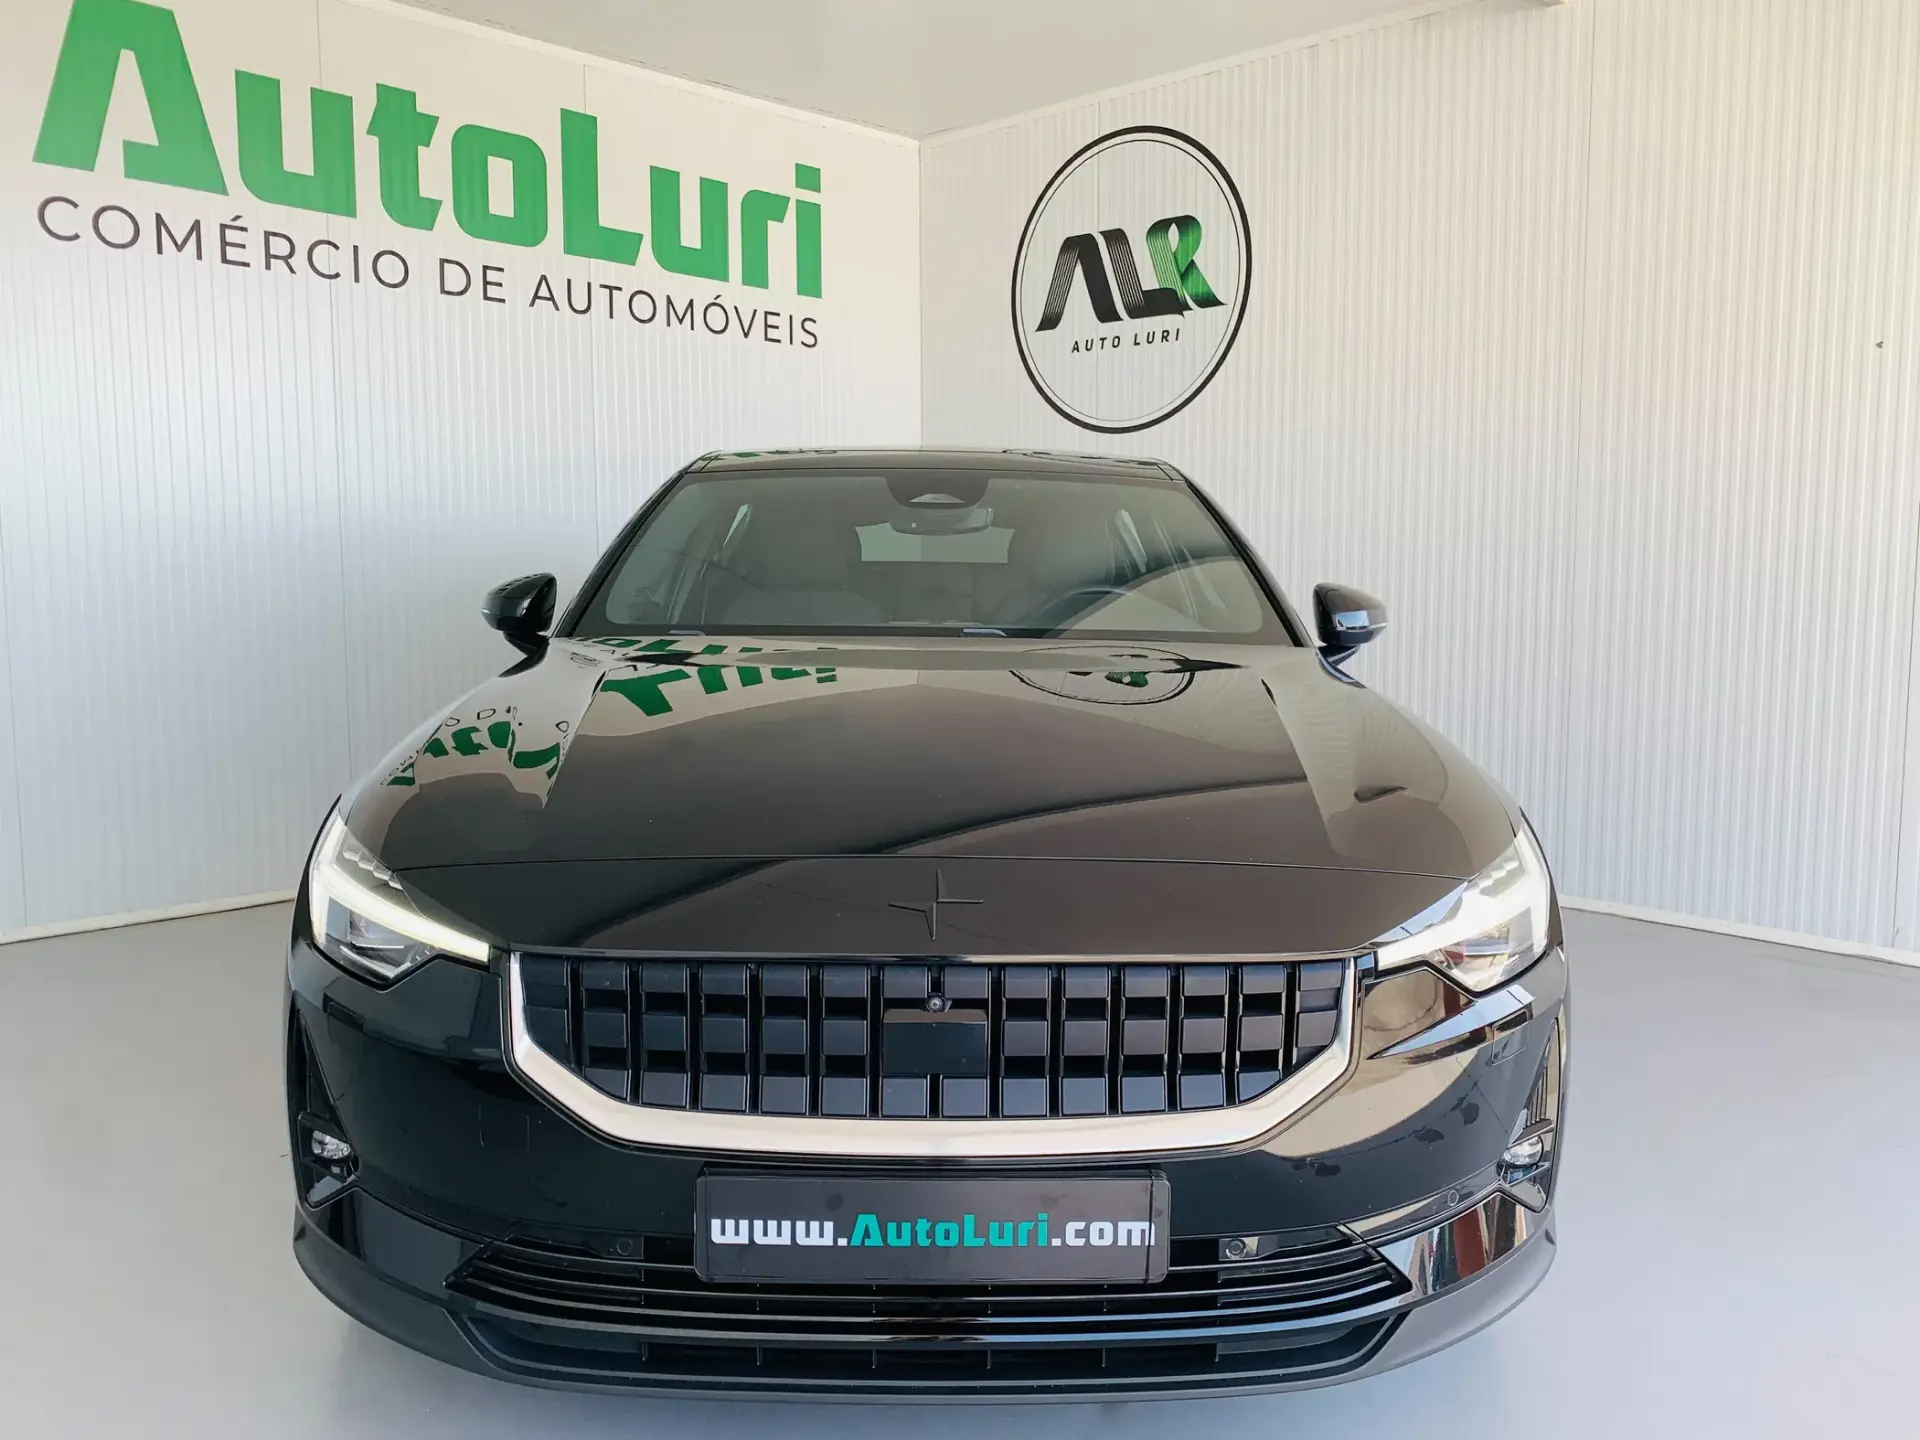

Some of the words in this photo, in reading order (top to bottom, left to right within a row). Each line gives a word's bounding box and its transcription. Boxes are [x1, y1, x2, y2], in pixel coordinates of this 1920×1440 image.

[32, 0, 823, 298] AutoLuri
[36, 196, 411, 289] COMÉRCIO
[439, 258, 507, 305] DE
[529, 273, 819, 348] AUTOMÓVEIS
[1071, 335, 1122, 353] AUTO
[1133, 327, 1181, 347] LURI
[710, 1212, 1156, 1248] www.AutoLuri.com
